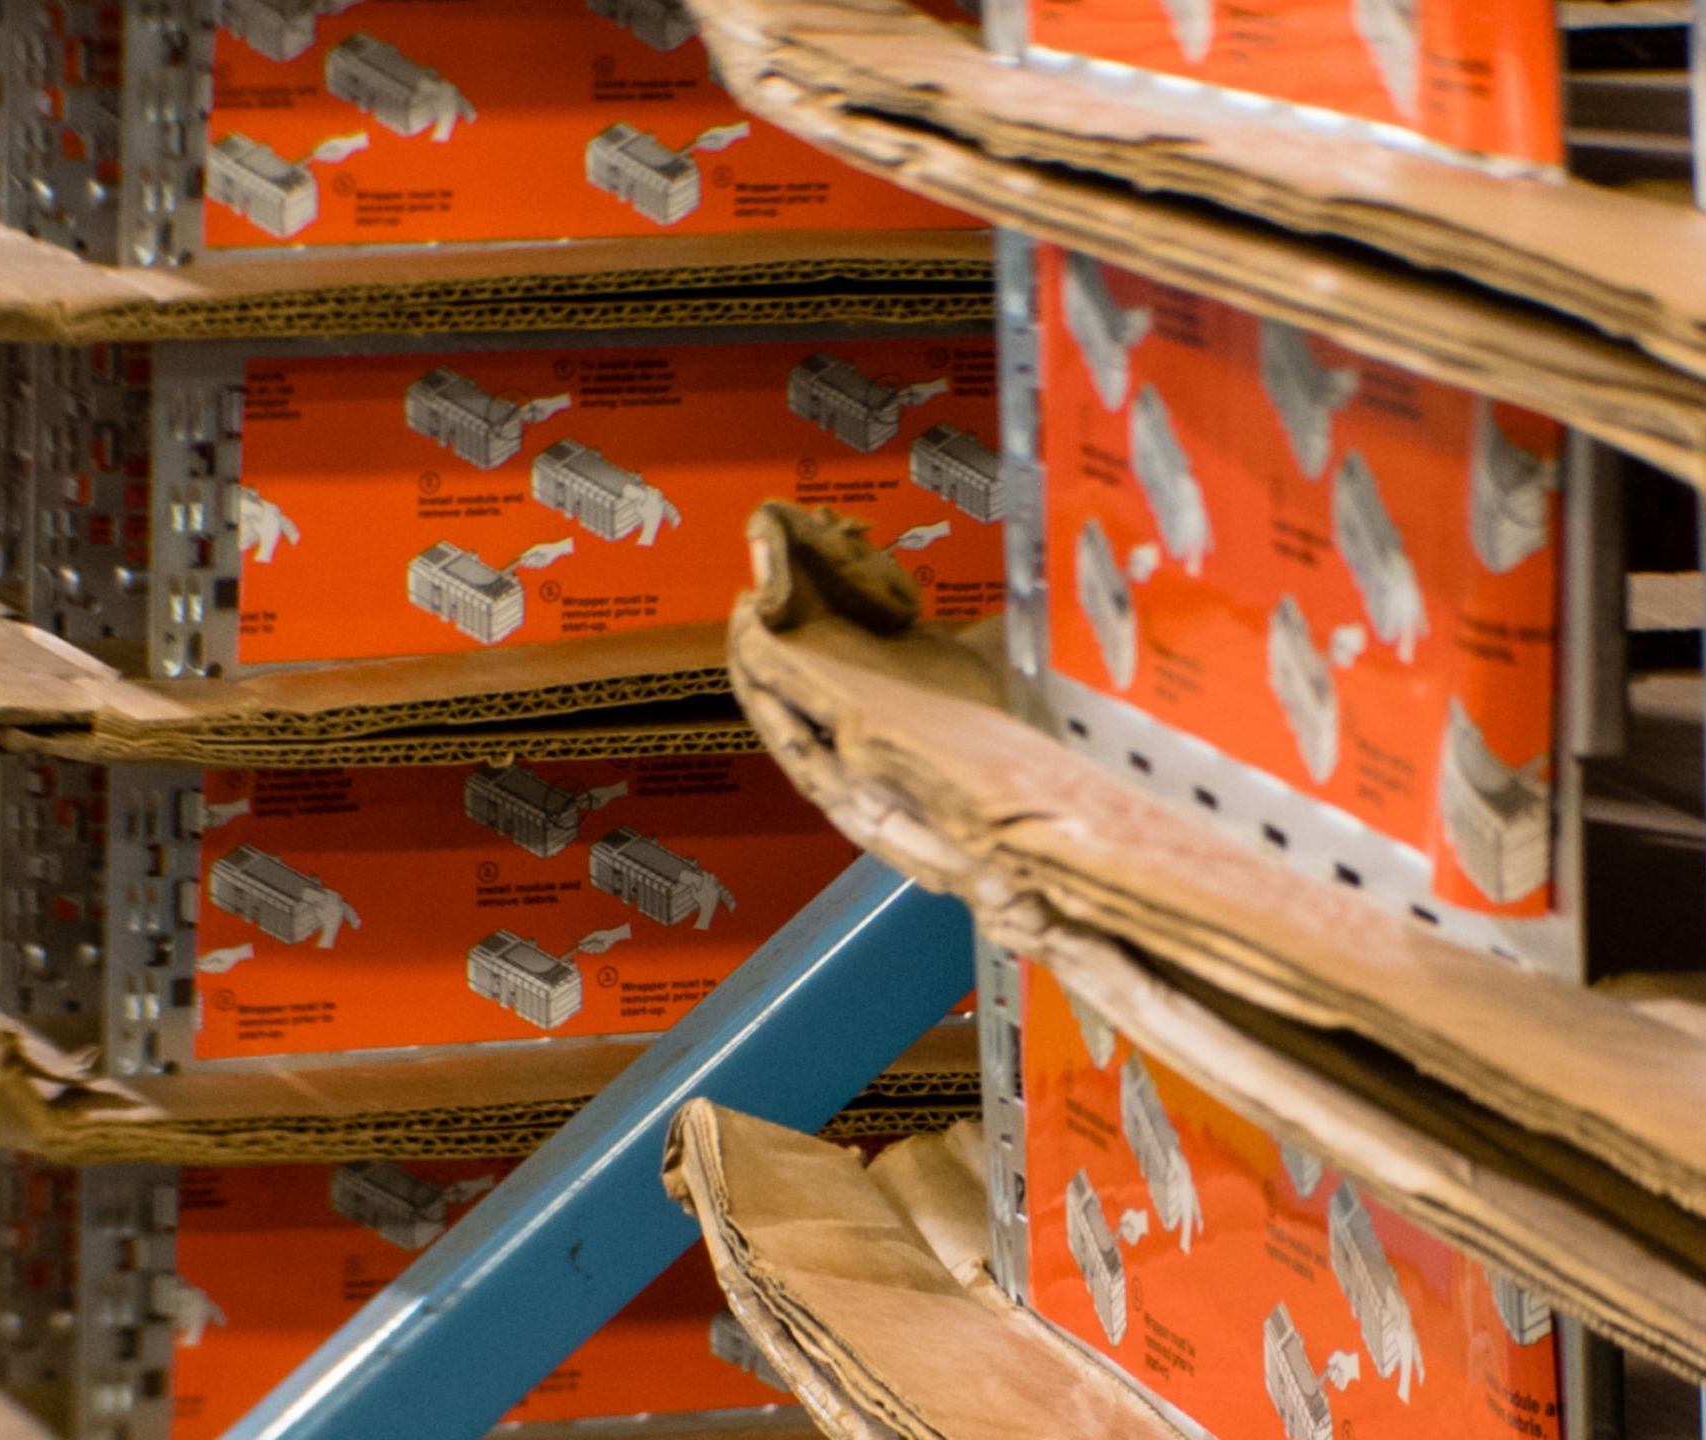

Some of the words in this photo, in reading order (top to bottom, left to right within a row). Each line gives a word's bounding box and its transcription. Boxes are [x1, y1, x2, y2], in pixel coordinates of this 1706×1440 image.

[561, 596, 611, 608] Wrapper
[613, 594, 642, 606] must
[645, 594, 659, 605] be
[561, 608, 612, 620] removed
[614, 607, 642, 620] prior
[645, 606, 657, 616] to
[477, 884, 512, 896] Install
[514, 881, 557, 894] module
[560, 880, 581, 892] and
[477, 897, 519, 908] remove
[523, 895, 560, 906] debris.
[620, 982, 669, 994] Wrapper
[671, 979, 699, 990] must
[620, 992, 670, 1004] removed
[673, 992, 699, 1004] prior
[620, 1006, 667, 1018] start-up.
